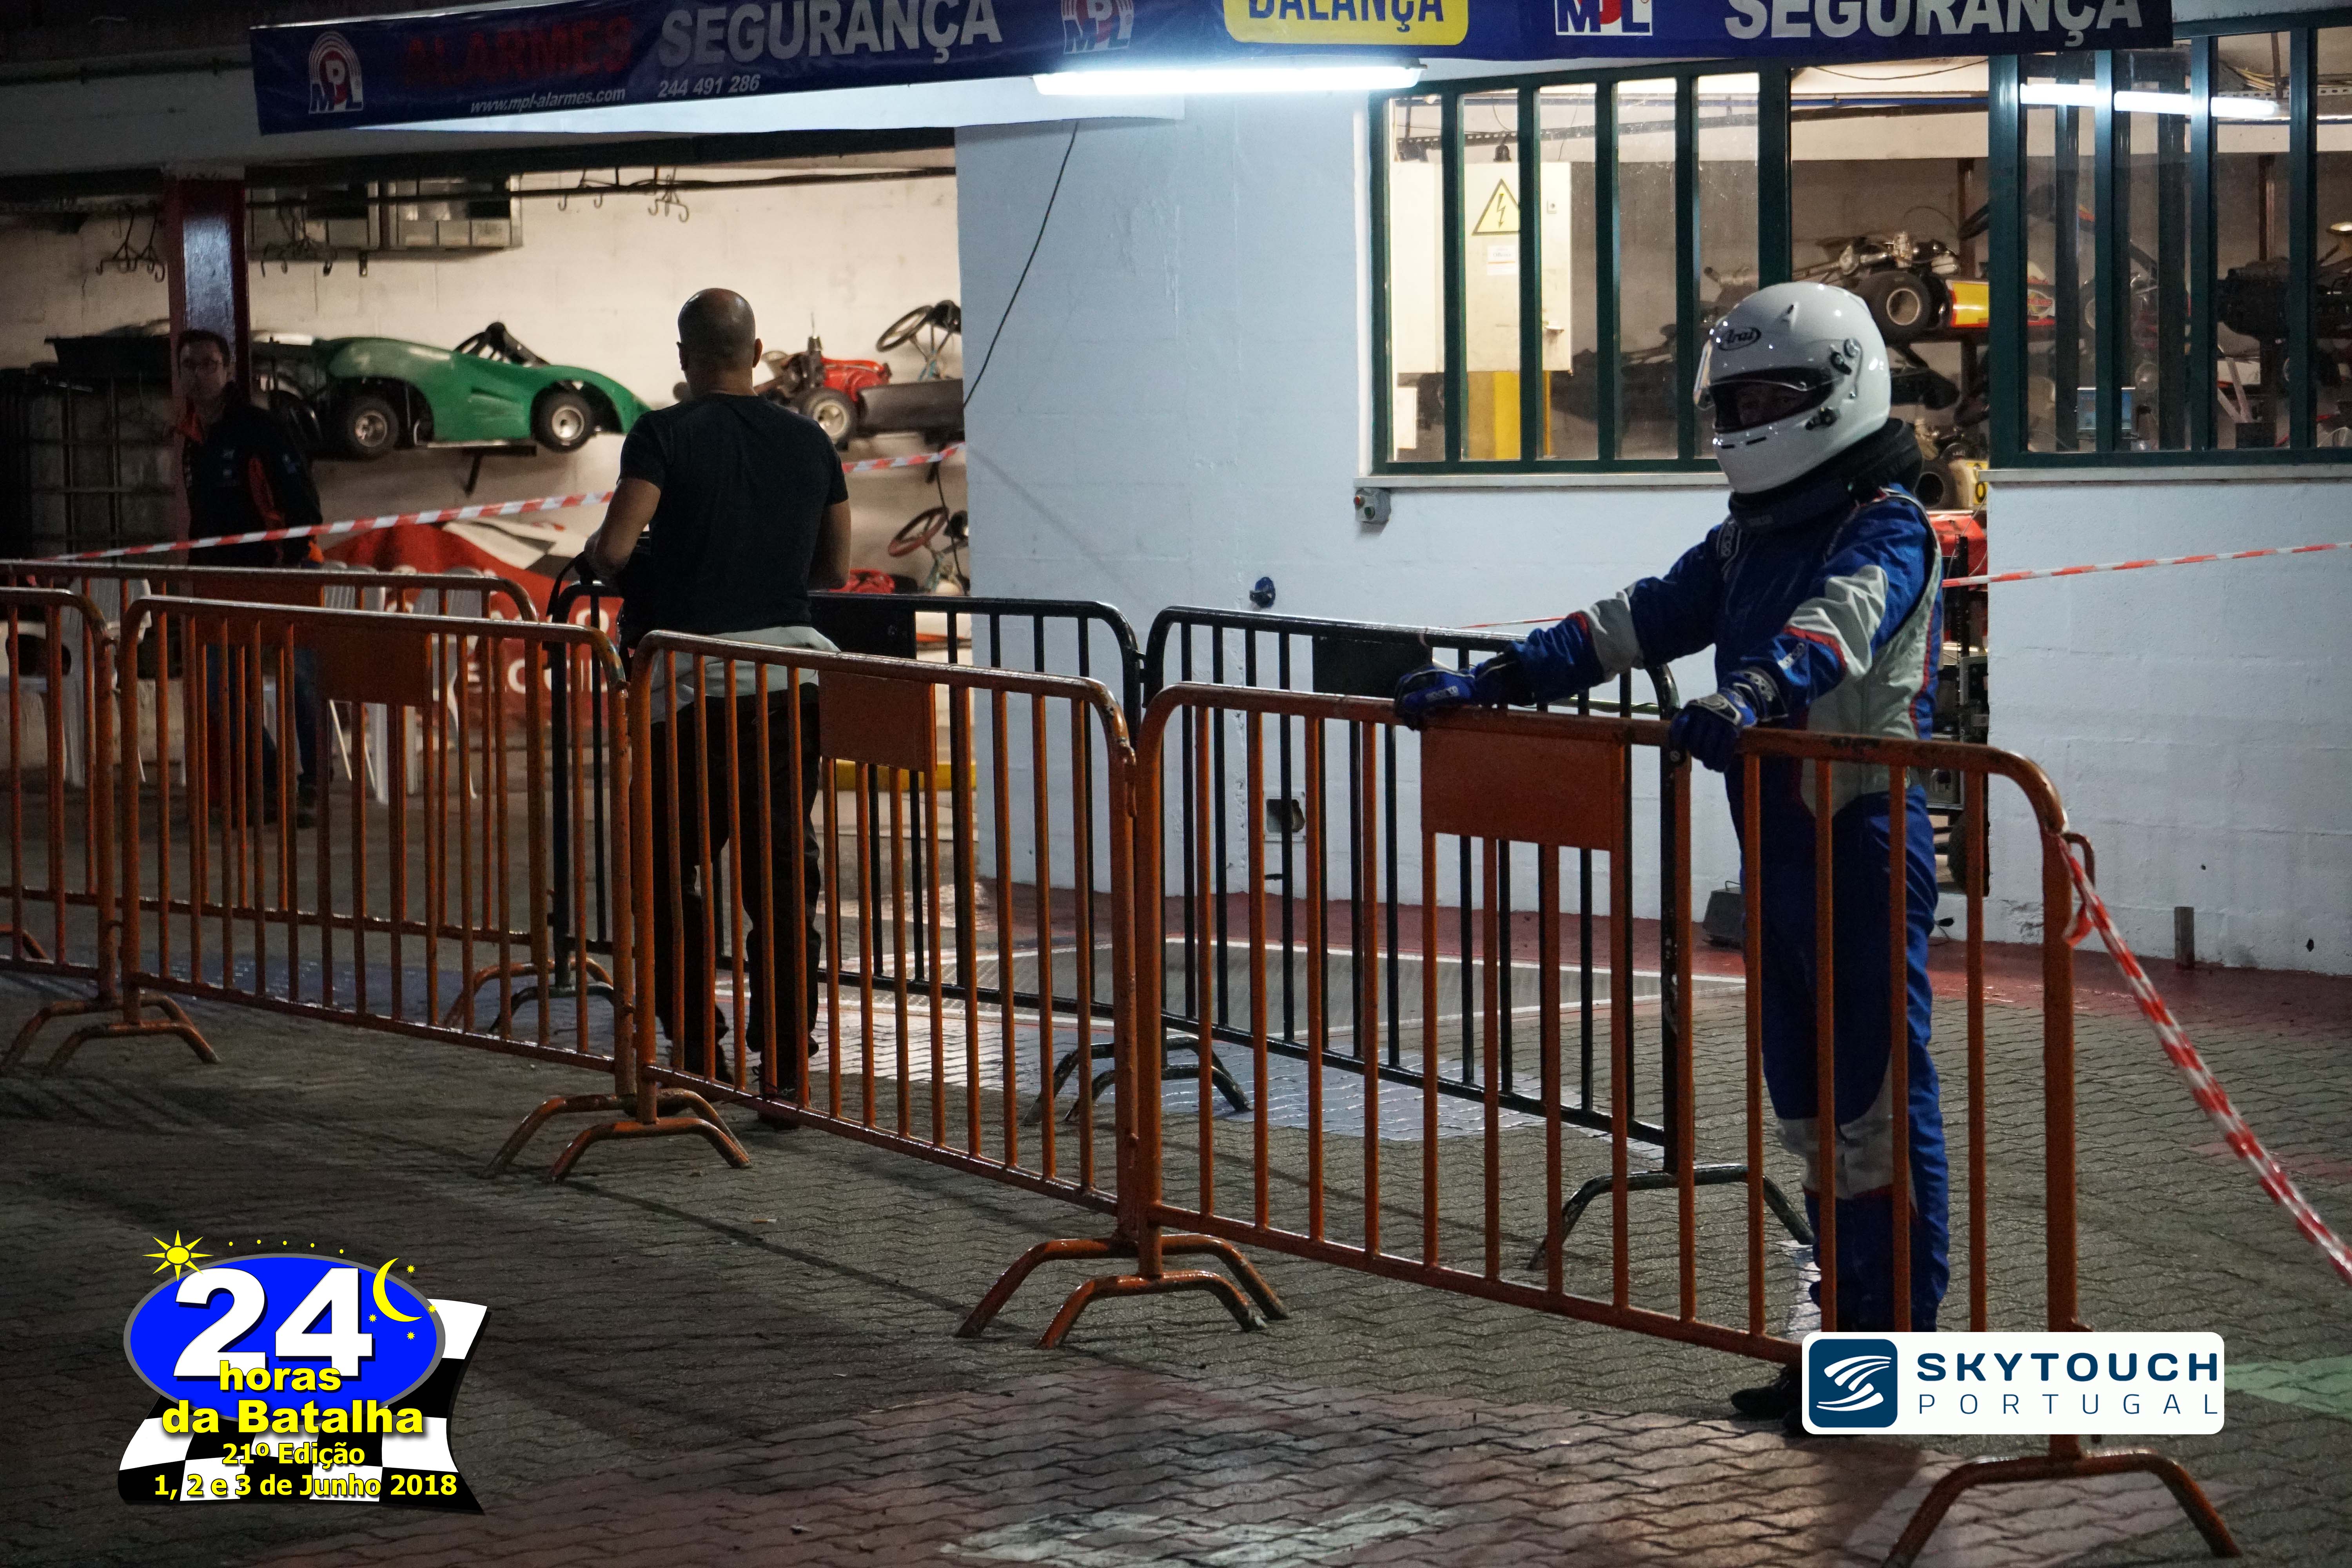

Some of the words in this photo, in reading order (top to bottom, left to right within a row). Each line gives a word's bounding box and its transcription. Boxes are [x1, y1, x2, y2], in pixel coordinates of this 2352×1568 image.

[1724, 0, 2143, 47] SEGURANÇA
[403, 16, 632, 85] ALARMES
[658, 0, 1002, 68] SEGURANÇA
[470, 89, 626, 114] www.mpl-alarmes.com
[657, 80, 689, 98] 244
[692, 76, 723, 95] 491
[728, 74, 761, 93] 286
